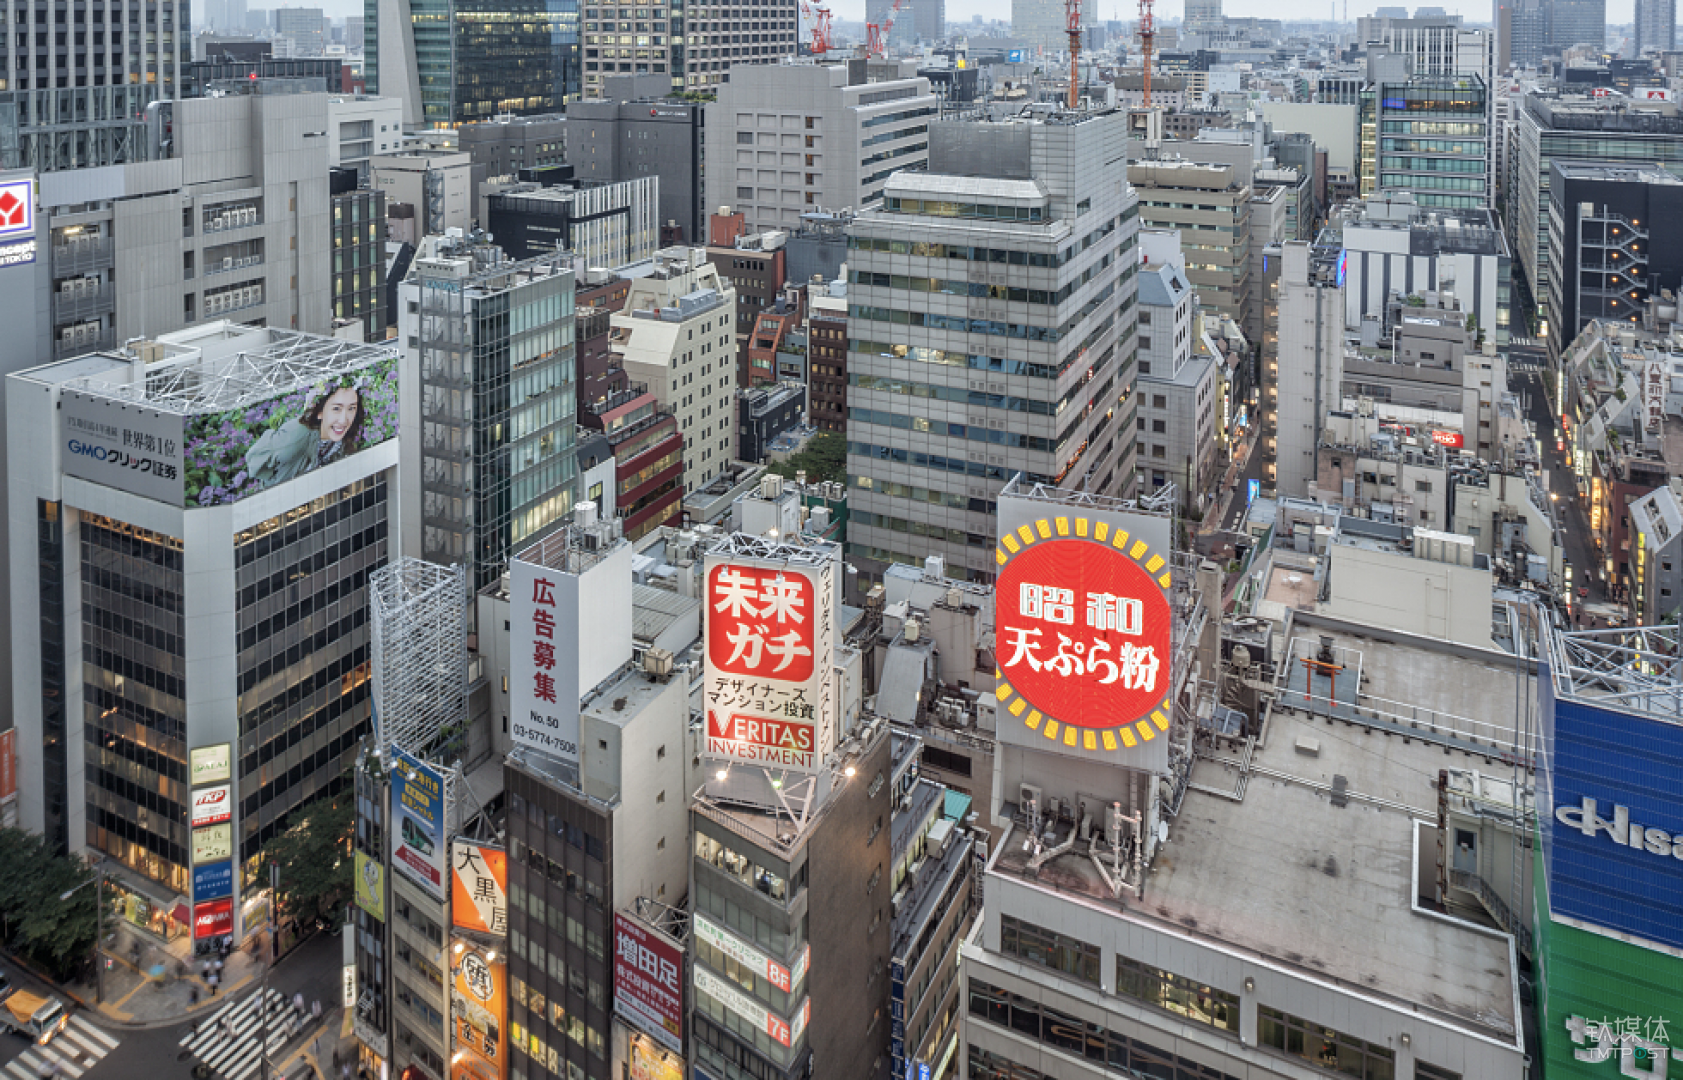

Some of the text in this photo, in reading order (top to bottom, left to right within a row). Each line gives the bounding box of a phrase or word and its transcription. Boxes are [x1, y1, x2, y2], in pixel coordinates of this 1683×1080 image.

[68, 439, 177, 480] GMOクリック証券
[123, 428, 176, 458] 世界第1位
[714, 570, 805, 624] 未来
[1019, 581, 1143, 636] 昭和
[532, 577, 557, 704] 広告募集
[725, 622, 812, 673] ガチ
[1004, 625, 1160, 693] 天ぷら粉
[708, 691, 815, 720] マンション投資
[716, 677, 807, 702] デザイナーズ
[530, 709, 559, 729] No. 50
[711, 709, 811, 750] VERITAS
[709, 738, 815, 768] INVESTMENT
[457, 847, 507, 934] 大黒屋
[616, 930, 679, 995] 増田足
[769, 963, 789, 988] 8F
[769, 1016, 789, 1041] 7F
